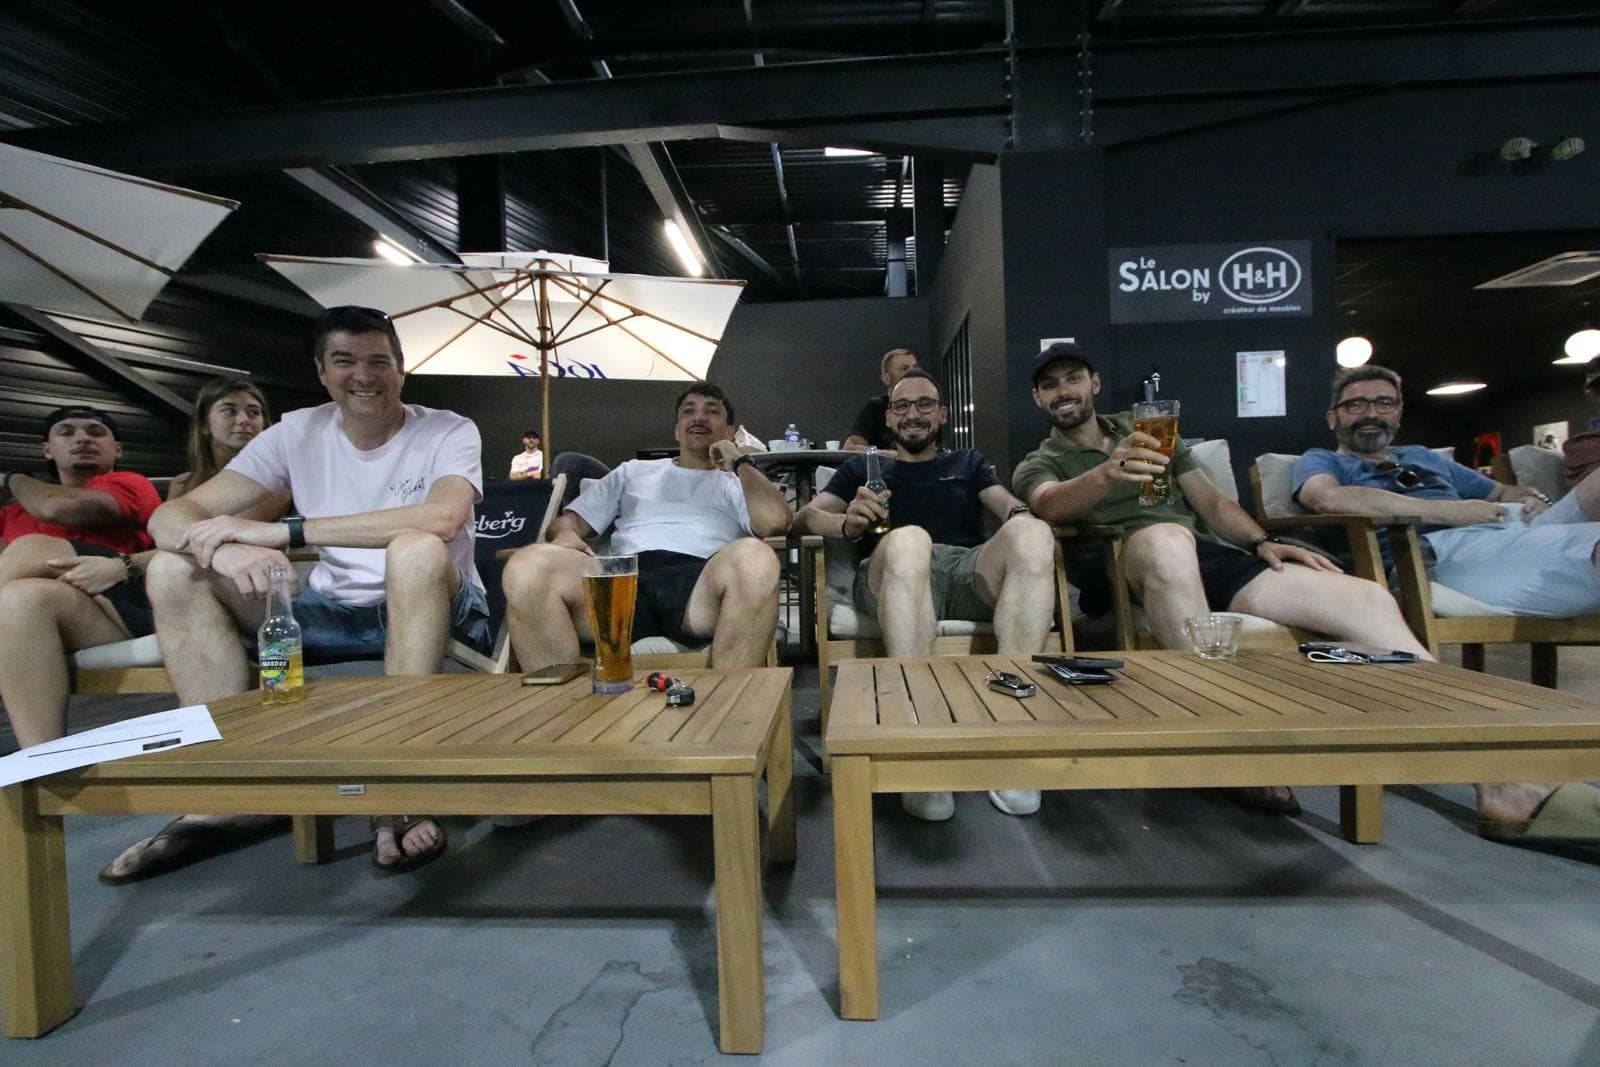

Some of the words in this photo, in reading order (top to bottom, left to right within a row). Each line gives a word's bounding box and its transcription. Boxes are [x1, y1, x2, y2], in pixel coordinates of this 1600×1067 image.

[1140, 256, 1156, 269] Le
[1119, 261, 1210, 292] SALON
[1233, 262, 1287, 290] H&H
[1192, 289, 1211, 304] by
[1223, 306, 1255, 314] créateur
[1256, 305, 1267, 313] de
[1268, 304, 1301, 312] meubles
